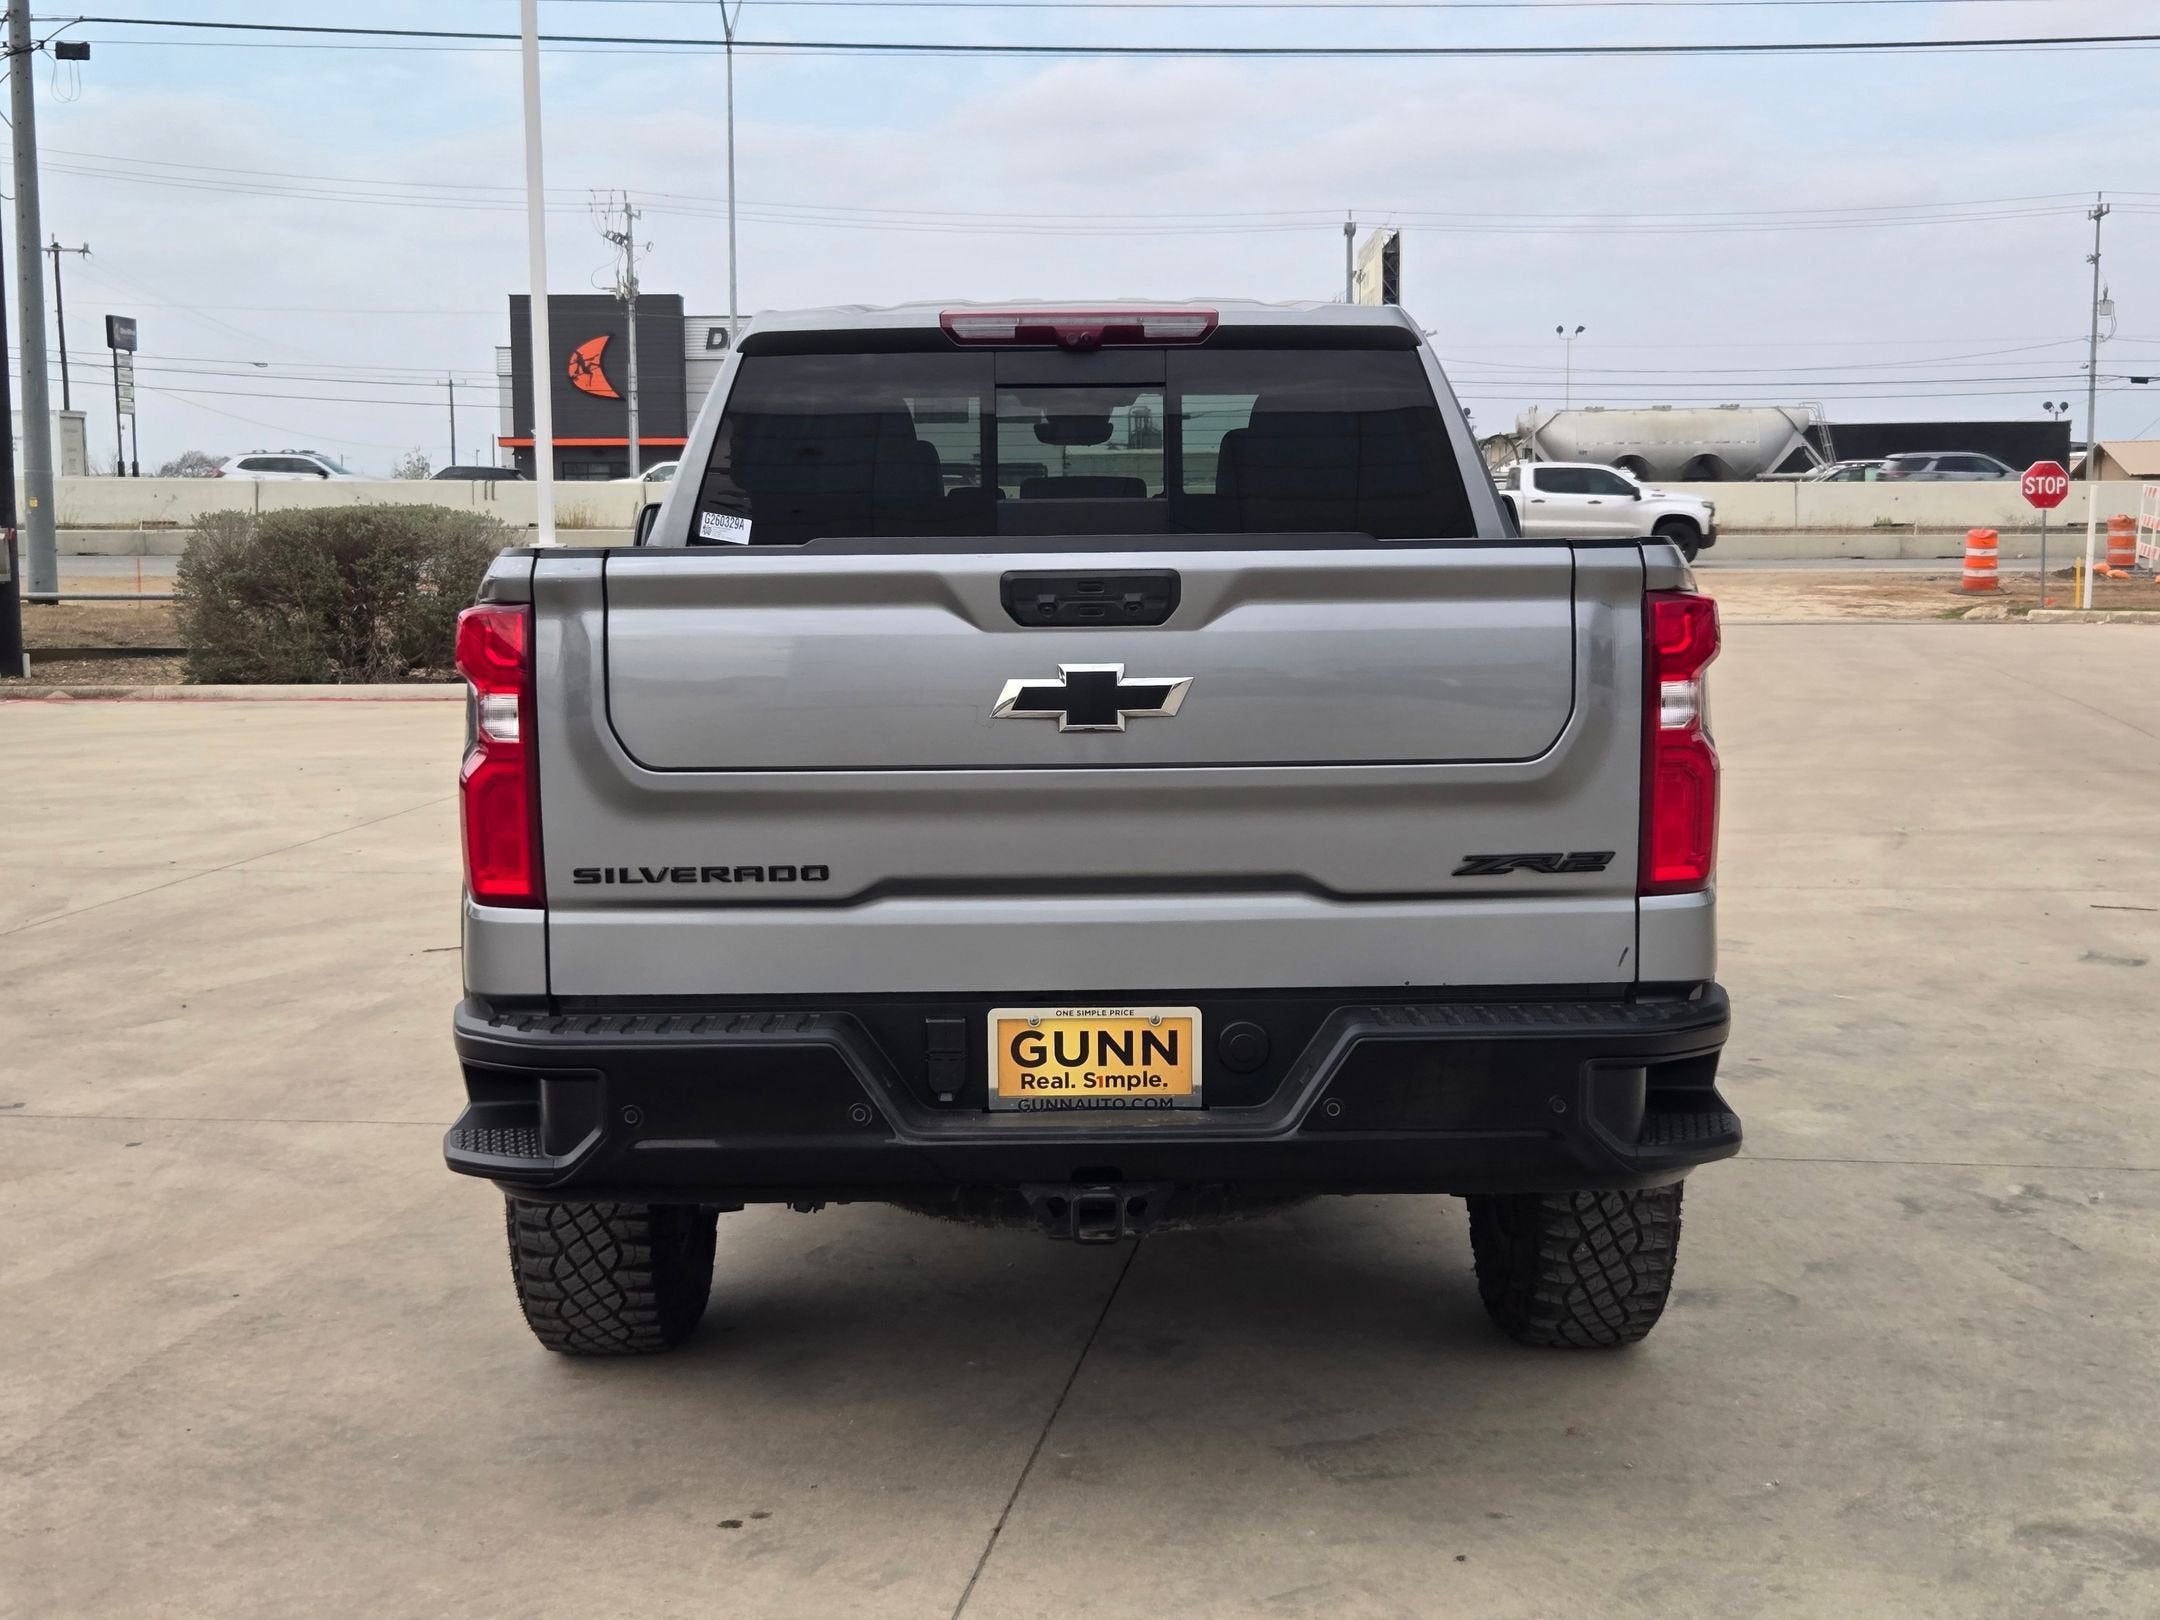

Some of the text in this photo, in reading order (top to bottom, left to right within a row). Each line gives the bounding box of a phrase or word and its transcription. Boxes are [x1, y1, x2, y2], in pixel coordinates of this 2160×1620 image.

[2025, 476, 2066, 495] STOP
[704, 512, 745, 530] G260329A
[1451, 851, 1616, 877] ZR2
[573, 865, 829, 884] SILVERADO
[1055, 1009, 1135, 1017] ONE SIMPLE PRICE
[1010, 1030, 1178, 1068] GUNN
[1020, 1072, 1076, 1090] Real.
[1018, 1098, 1174, 1112] GUNNAUTO.COM
